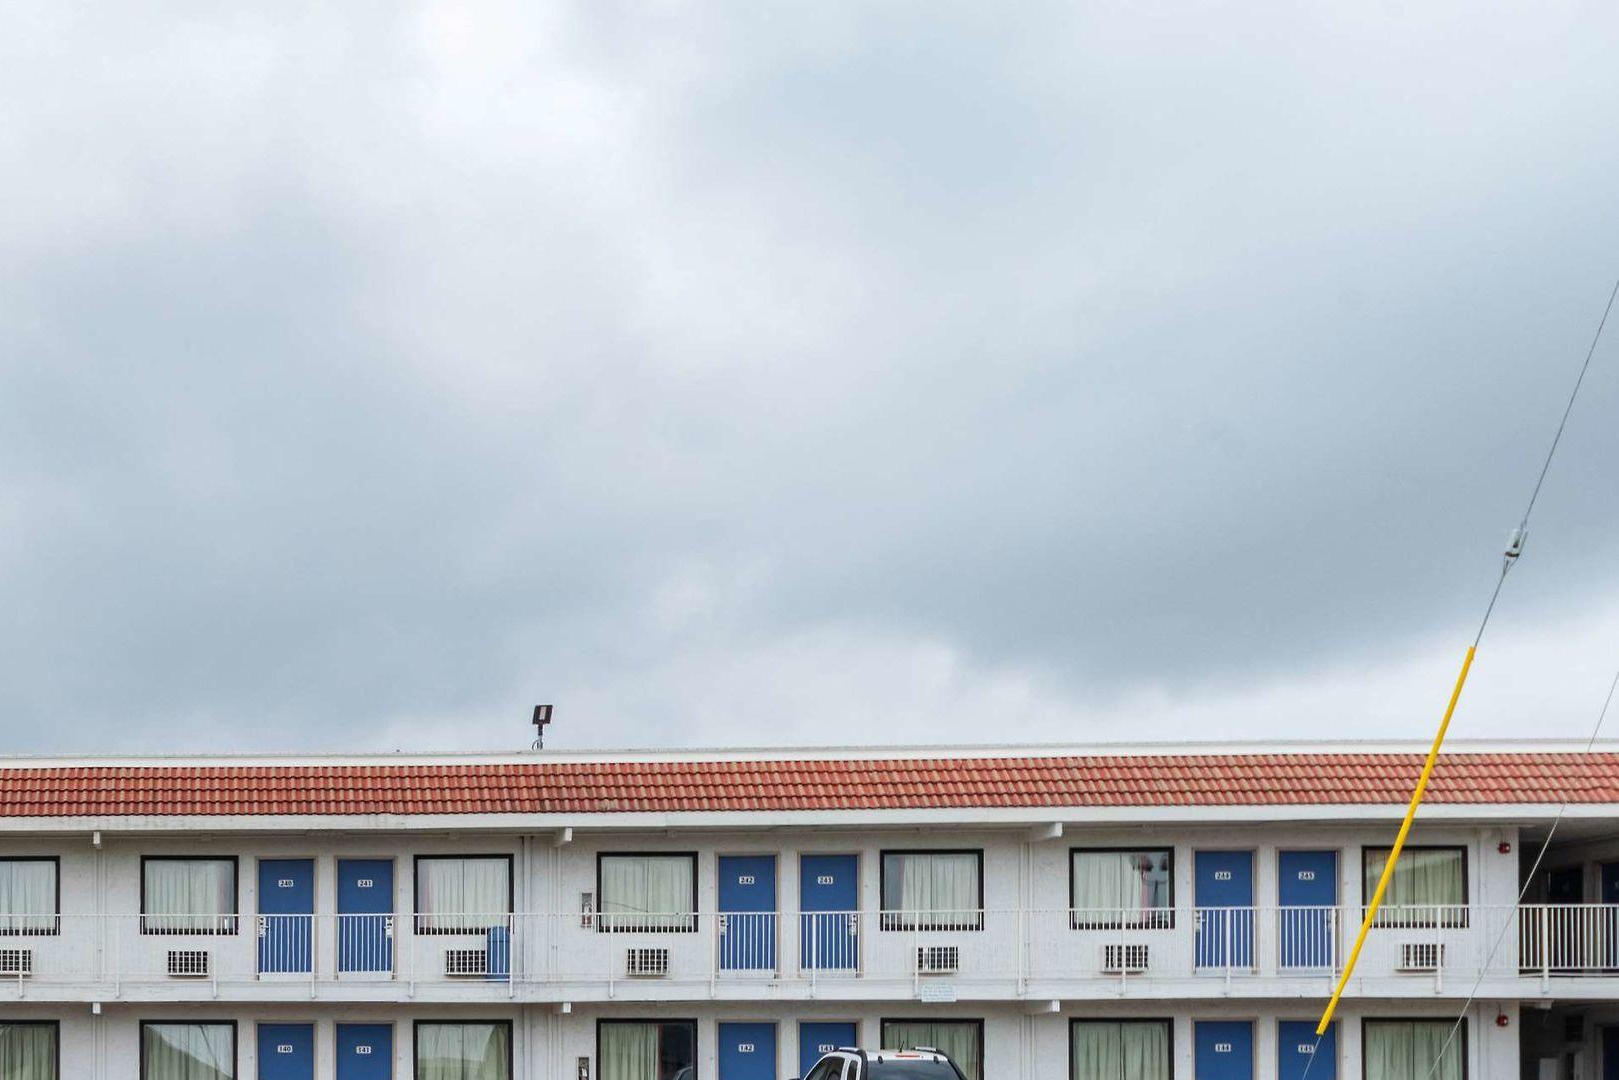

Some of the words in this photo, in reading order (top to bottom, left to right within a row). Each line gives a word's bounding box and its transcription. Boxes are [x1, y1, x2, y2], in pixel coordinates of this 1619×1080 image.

[739, 876, 754, 884] 242
[278, 1045, 292, 1053] 140
[739, 1044, 754, 1052] 142
